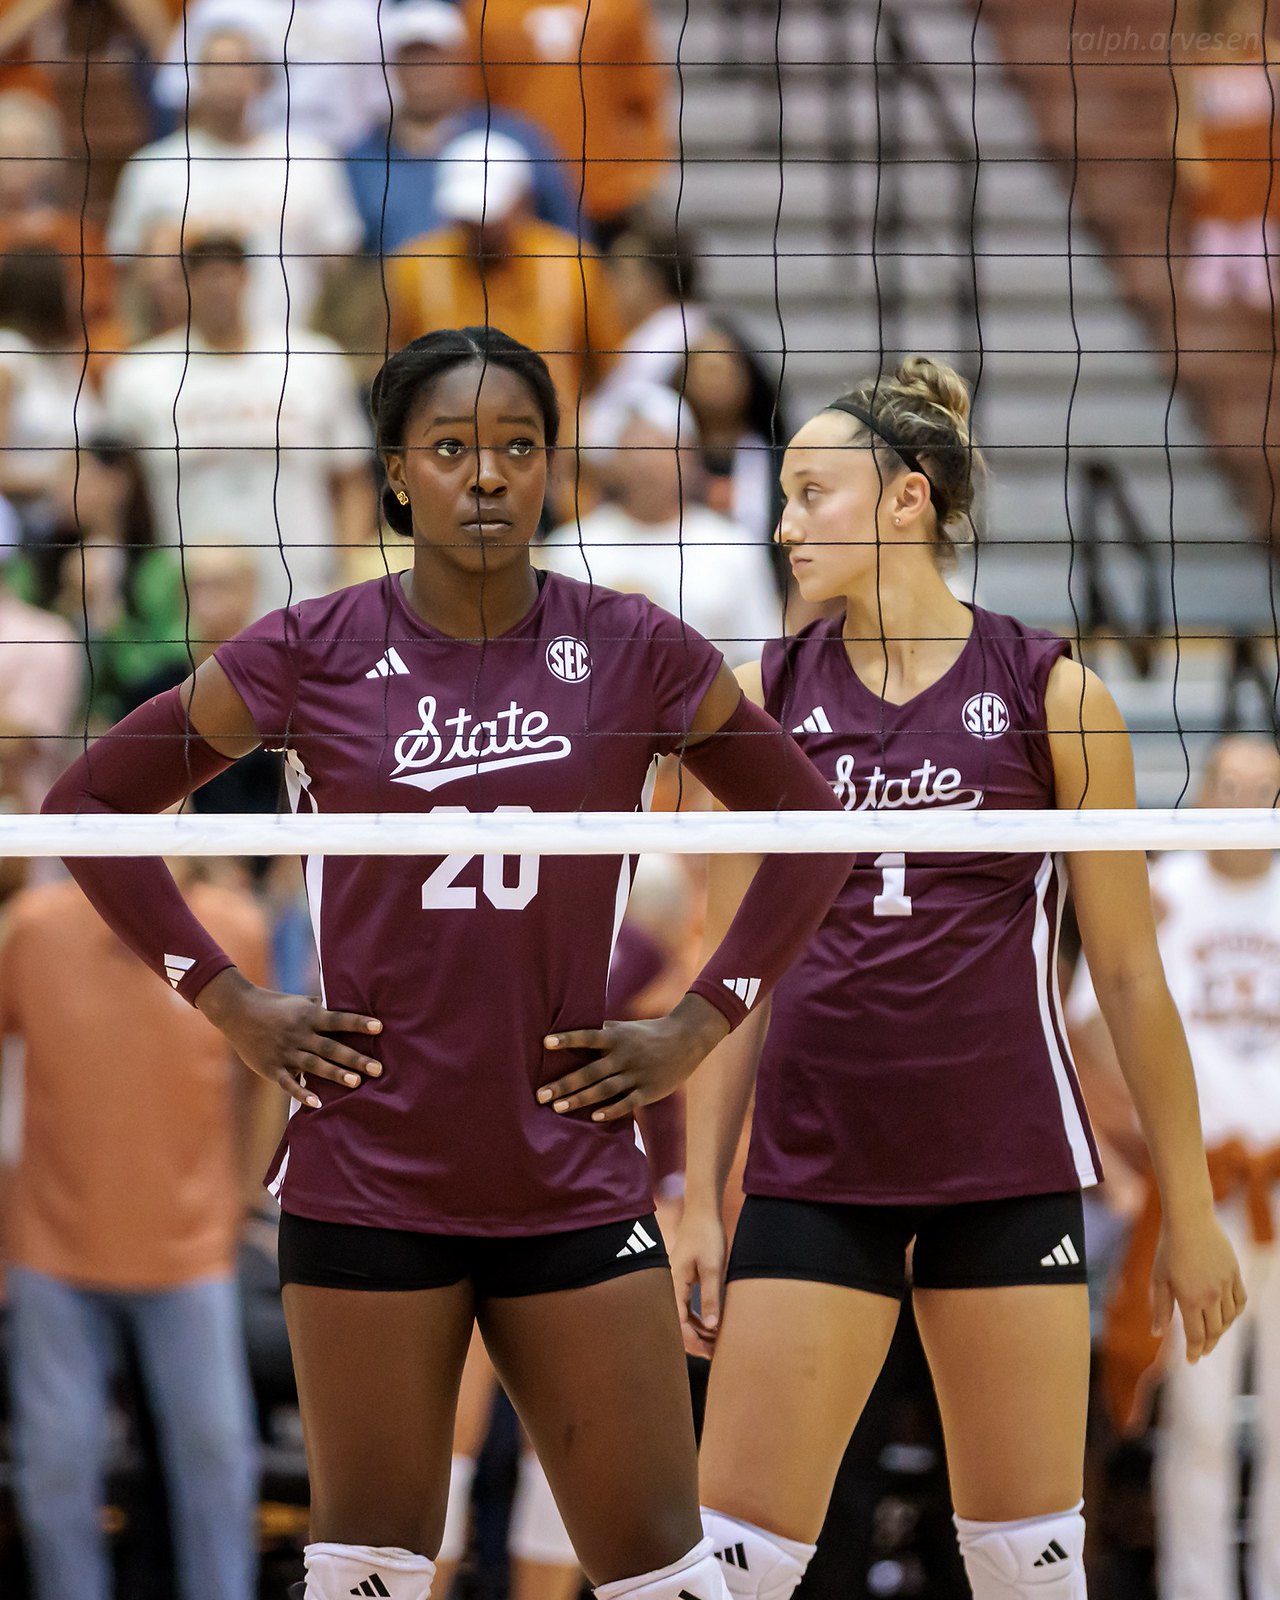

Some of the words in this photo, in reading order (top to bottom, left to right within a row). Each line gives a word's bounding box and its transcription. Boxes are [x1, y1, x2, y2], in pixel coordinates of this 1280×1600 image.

[549, 639, 589, 680] SEC
[389, 695, 572, 792] State
[965, 696, 1007, 735] SEC
[421, 805, 540, 910] 20
[873, 852, 912, 916] 1
